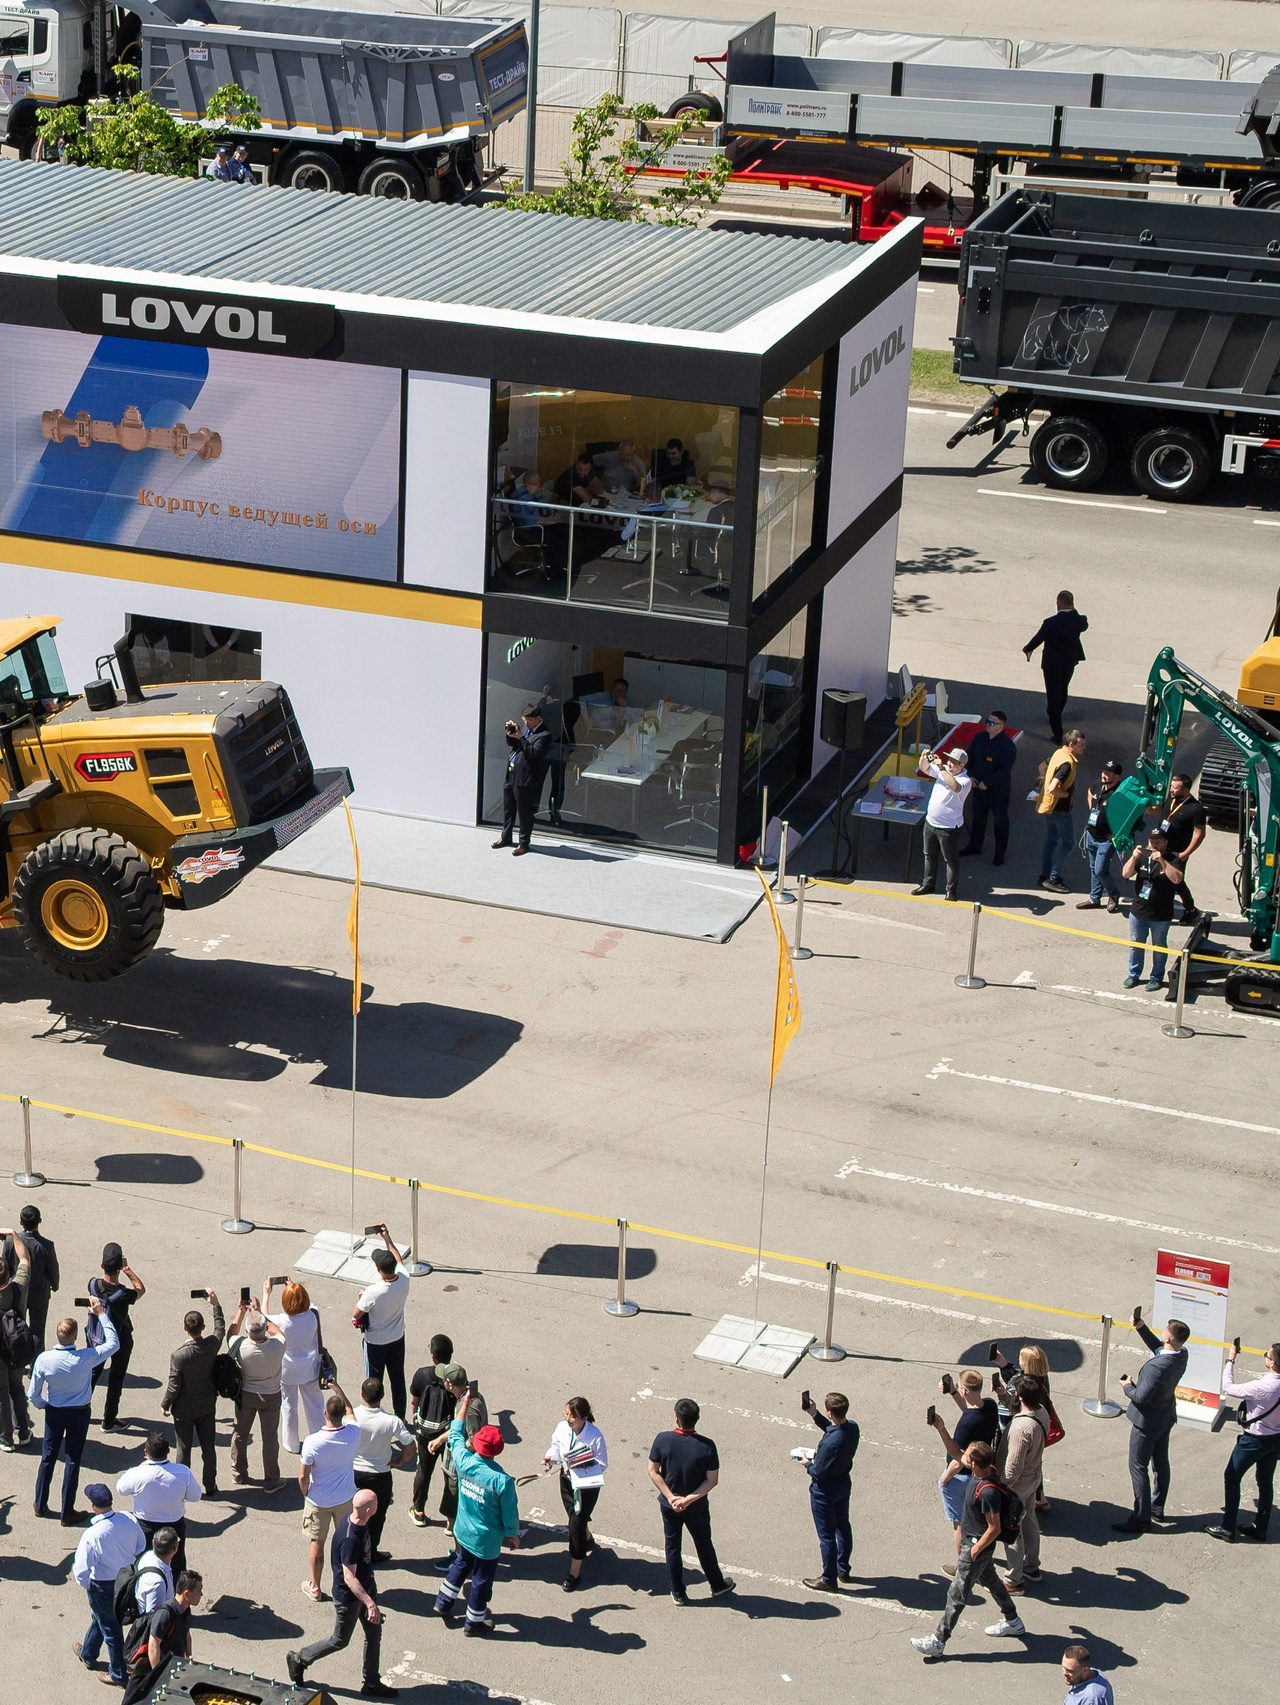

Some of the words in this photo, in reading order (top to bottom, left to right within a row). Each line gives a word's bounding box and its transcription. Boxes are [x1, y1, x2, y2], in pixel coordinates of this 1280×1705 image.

[489, 61, 526, 91] ТЕСТ-ДРАЙВ
[787, 103, 827, 111] www.politrans.ru
[102, 293, 286, 343] LOVOL
[850, 324, 906, 397] LOVOL
[137, 487, 220, 517] Корпус
[228, 503, 328, 529] ведущей
[337, 518, 377, 535] оси
[1215, 711, 1253, 748] LOVOL
[85, 757, 134, 773] FL956K
[461, 1478, 485, 1496] СКОРАЯ
